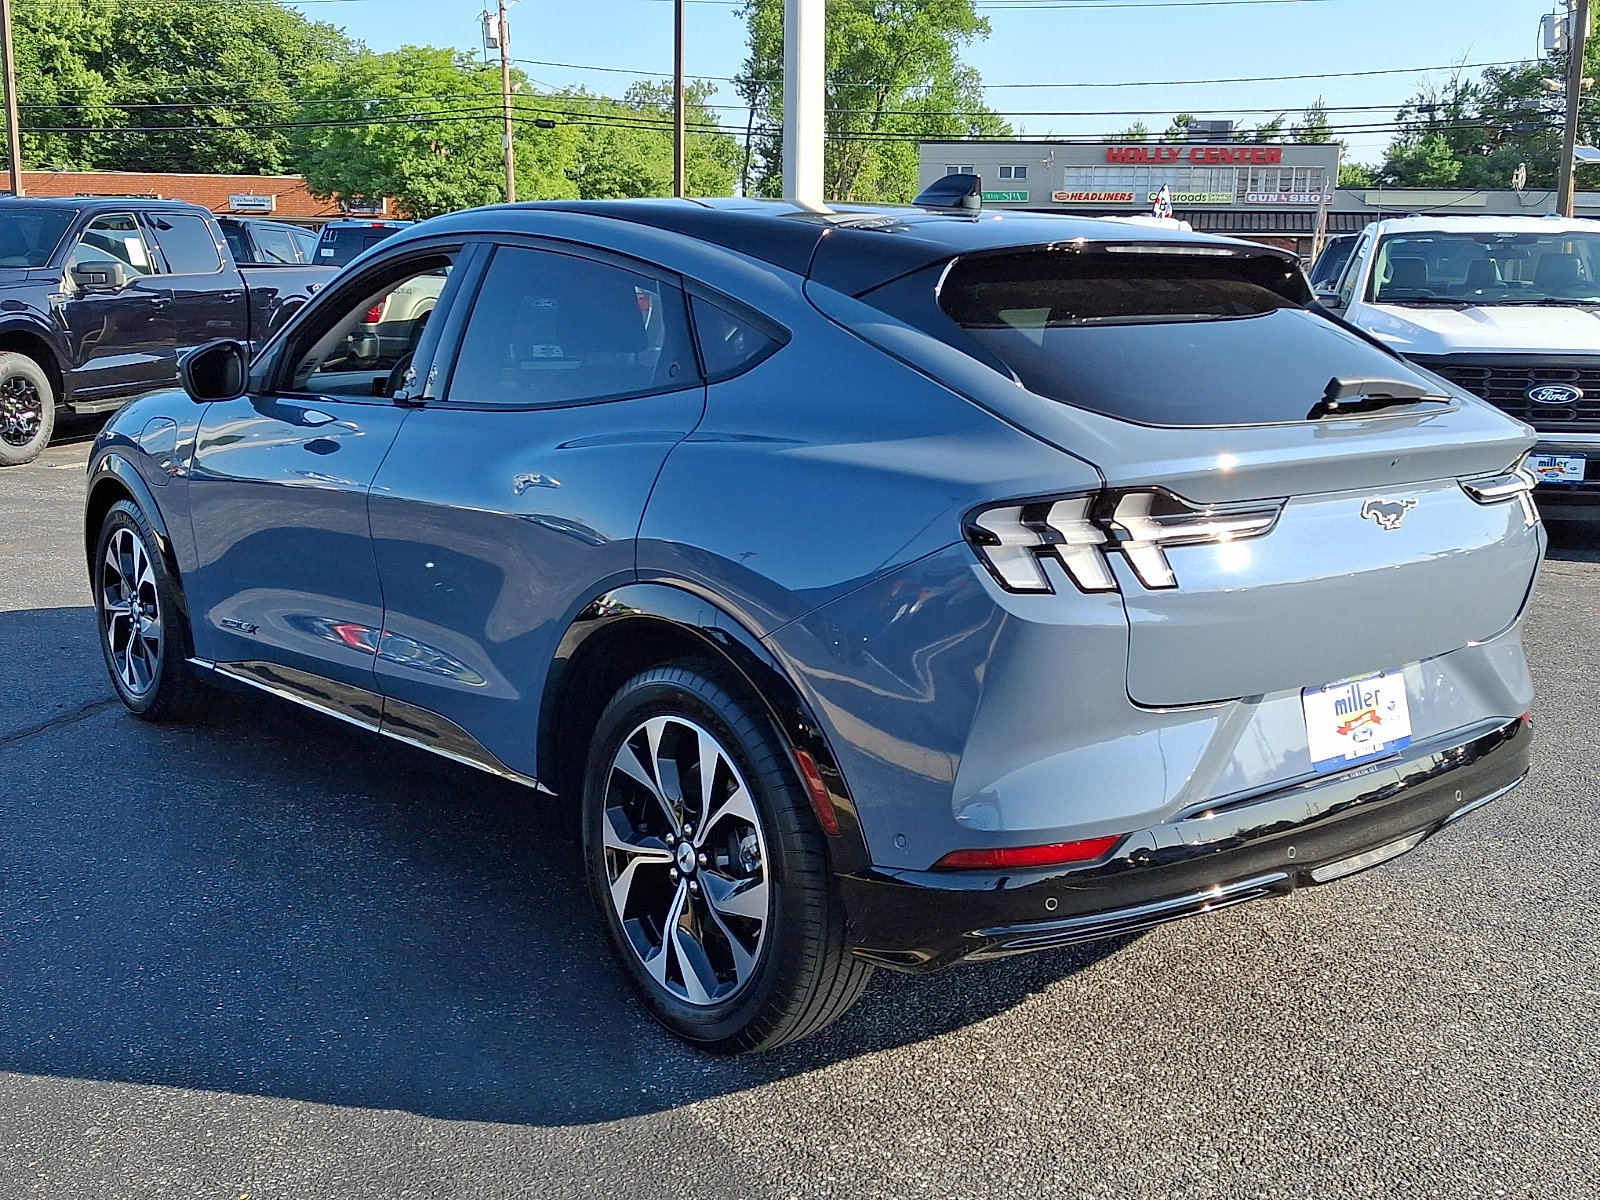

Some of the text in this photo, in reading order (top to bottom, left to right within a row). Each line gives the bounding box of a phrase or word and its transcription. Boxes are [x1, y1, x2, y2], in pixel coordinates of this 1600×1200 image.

[1106, 147, 1283, 165] HOLLY CENTER
[1002, 192, 1022, 201] SPA
[1070, 192, 1134, 201] HEADLINERS
[1248, 194, 1332, 203] GUN SHOP
[1538, 388, 1570, 401] Ford
[1538, 457, 1570, 468] miller
[1335, 682, 1381, 717] miller
